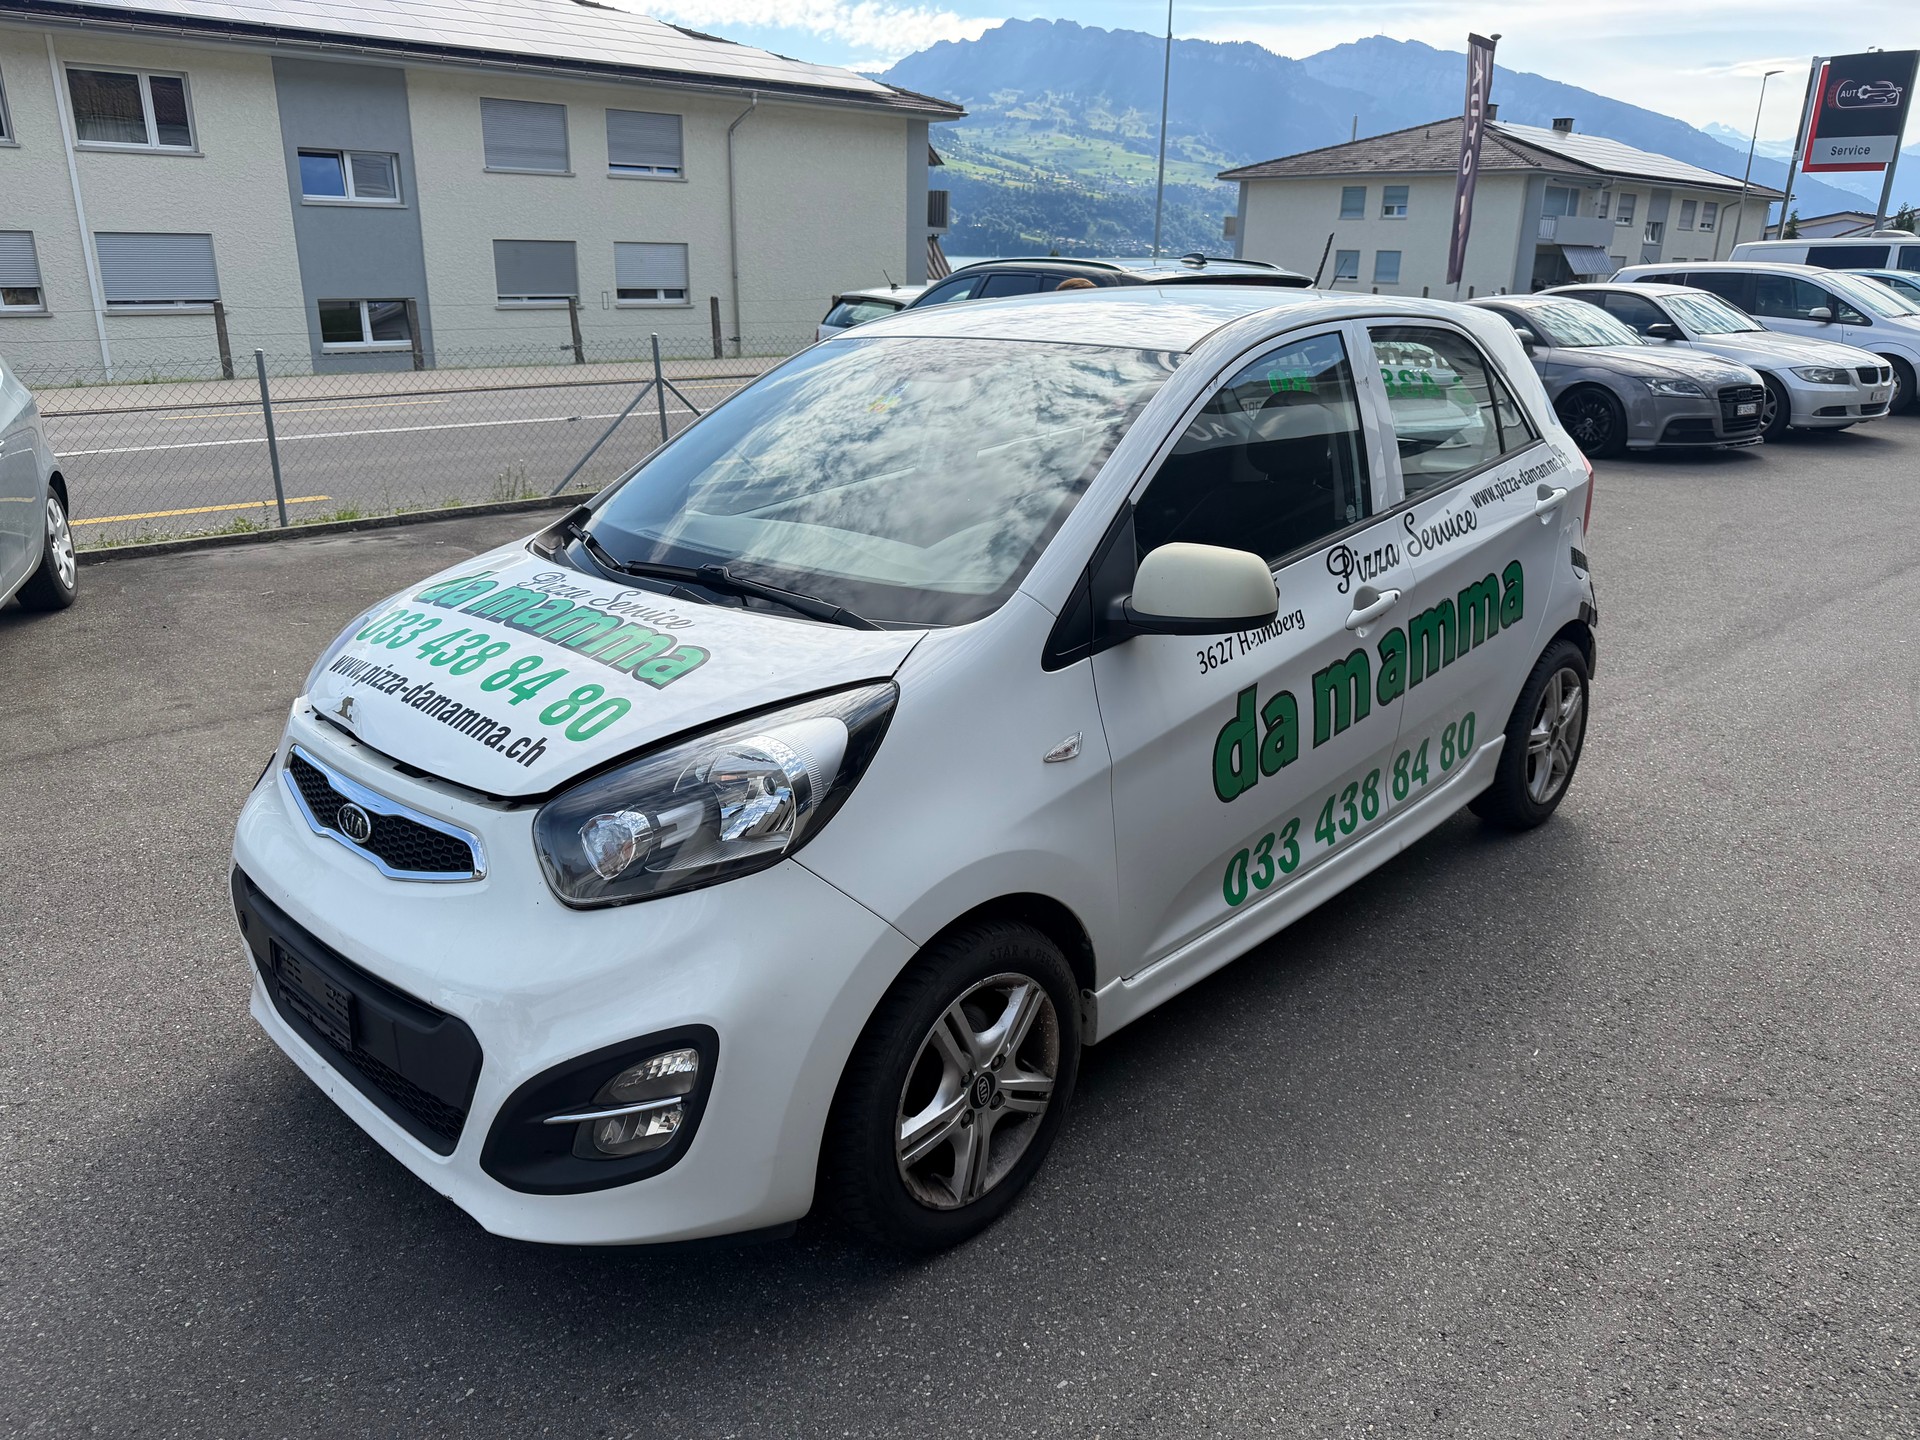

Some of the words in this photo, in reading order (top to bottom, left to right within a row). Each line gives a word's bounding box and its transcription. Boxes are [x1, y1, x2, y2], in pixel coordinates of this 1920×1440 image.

[1461, 60, 1484, 175] AUTO
[1830, 145, 1871, 156] Service
[516, 571, 593, 599] Pizza
[589, 590, 696, 630] Service
[1326, 544, 1400, 594] Pizza
[1403, 509, 1477, 557] Service
[356, 609, 443, 650] 033
[415, 628, 511, 676] 438
[480, 655, 570, 706] 84
[538, 683, 632, 742] 80
[412, 570, 499, 610] da
[458, 585, 711, 691] mamma
[1196, 635, 1234, 675] 3627
[1212, 682, 1299, 803] da
[1312, 559, 1524, 749] mamma
[328, 654, 548, 768] www.pizza-damamma.ch
[1222, 817, 1301, 907] 033
[1314, 768, 1381, 847] 438
[1392, 737, 1431, 802] 84
[1440, 711, 1476, 773] 80
